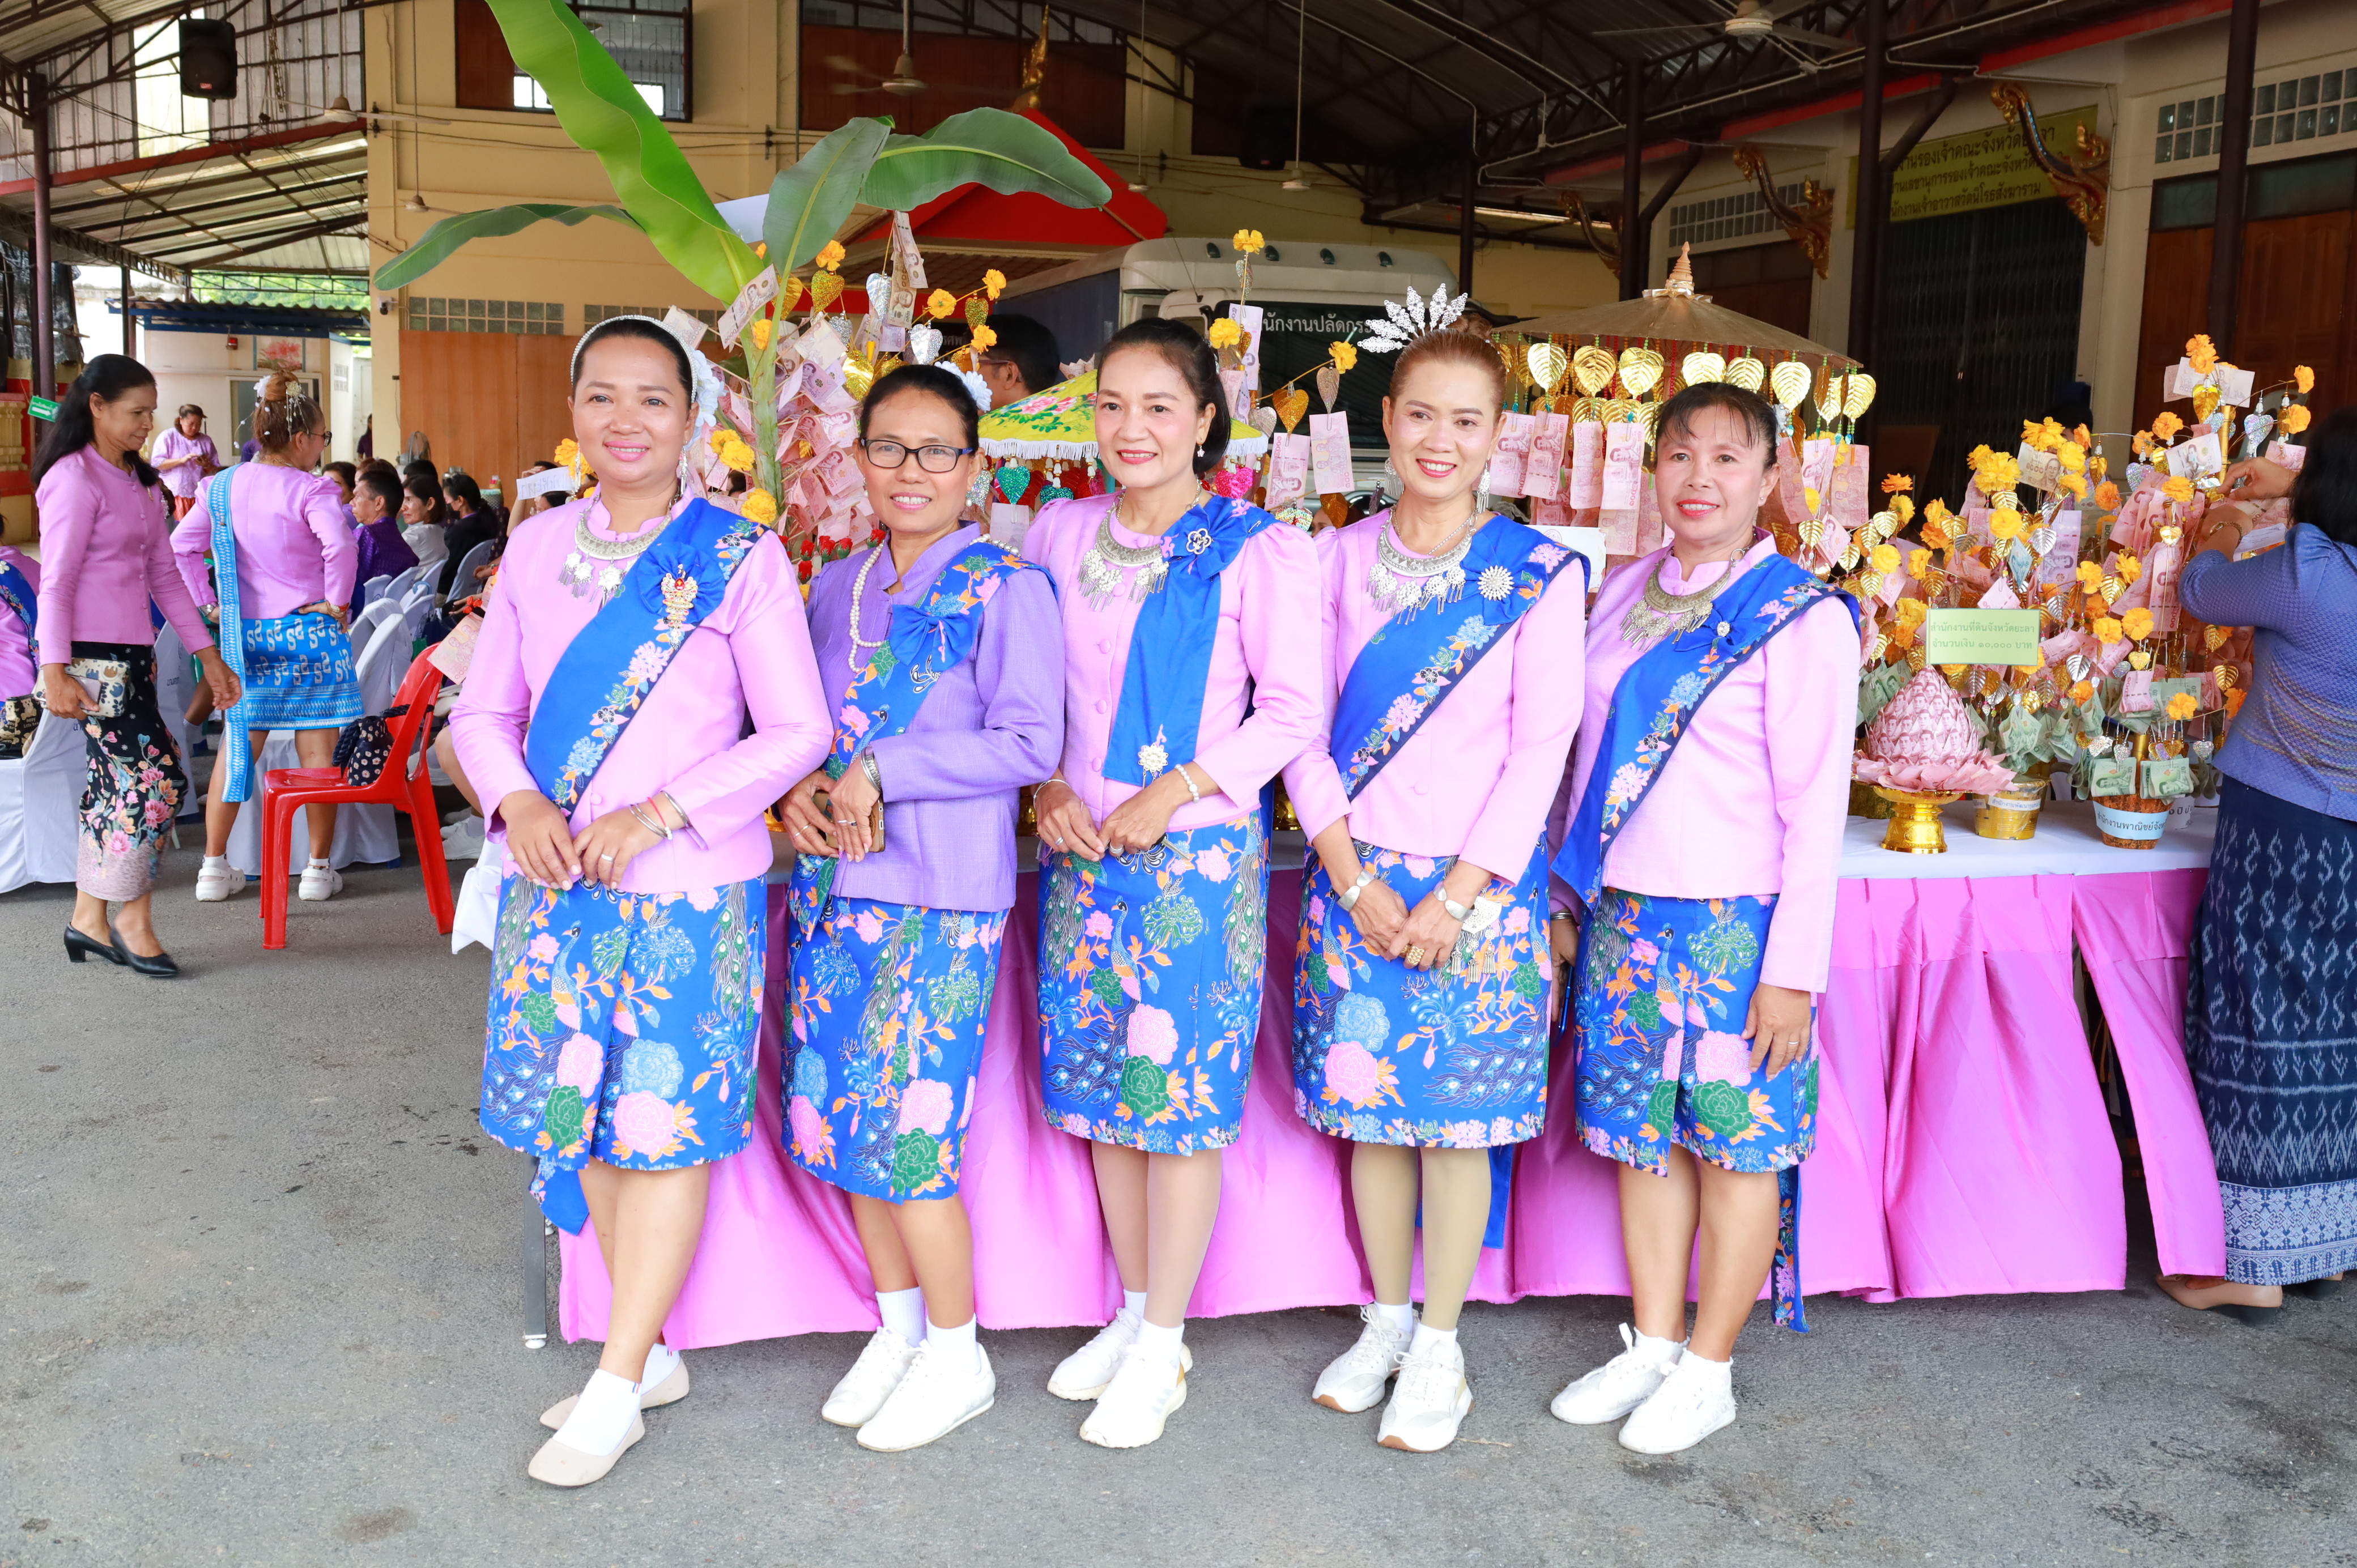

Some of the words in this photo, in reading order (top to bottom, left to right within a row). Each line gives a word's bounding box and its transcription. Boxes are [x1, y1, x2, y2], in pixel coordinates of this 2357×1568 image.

[1892, 181, 2041, 216] นักงานเจ้าอาวาสวัดนิโรธสังฆาราม
[1262, 312, 1372, 334] นักงานปลัดกระ
[1931, 620, 2035, 633] สำนักงานที่ดินจังหวัดยะลา
[1932, 638, 1975, 649] จำนวนเงิน
[2098, 811, 2167, 831] สำนักงานพาณิชย์จังห
